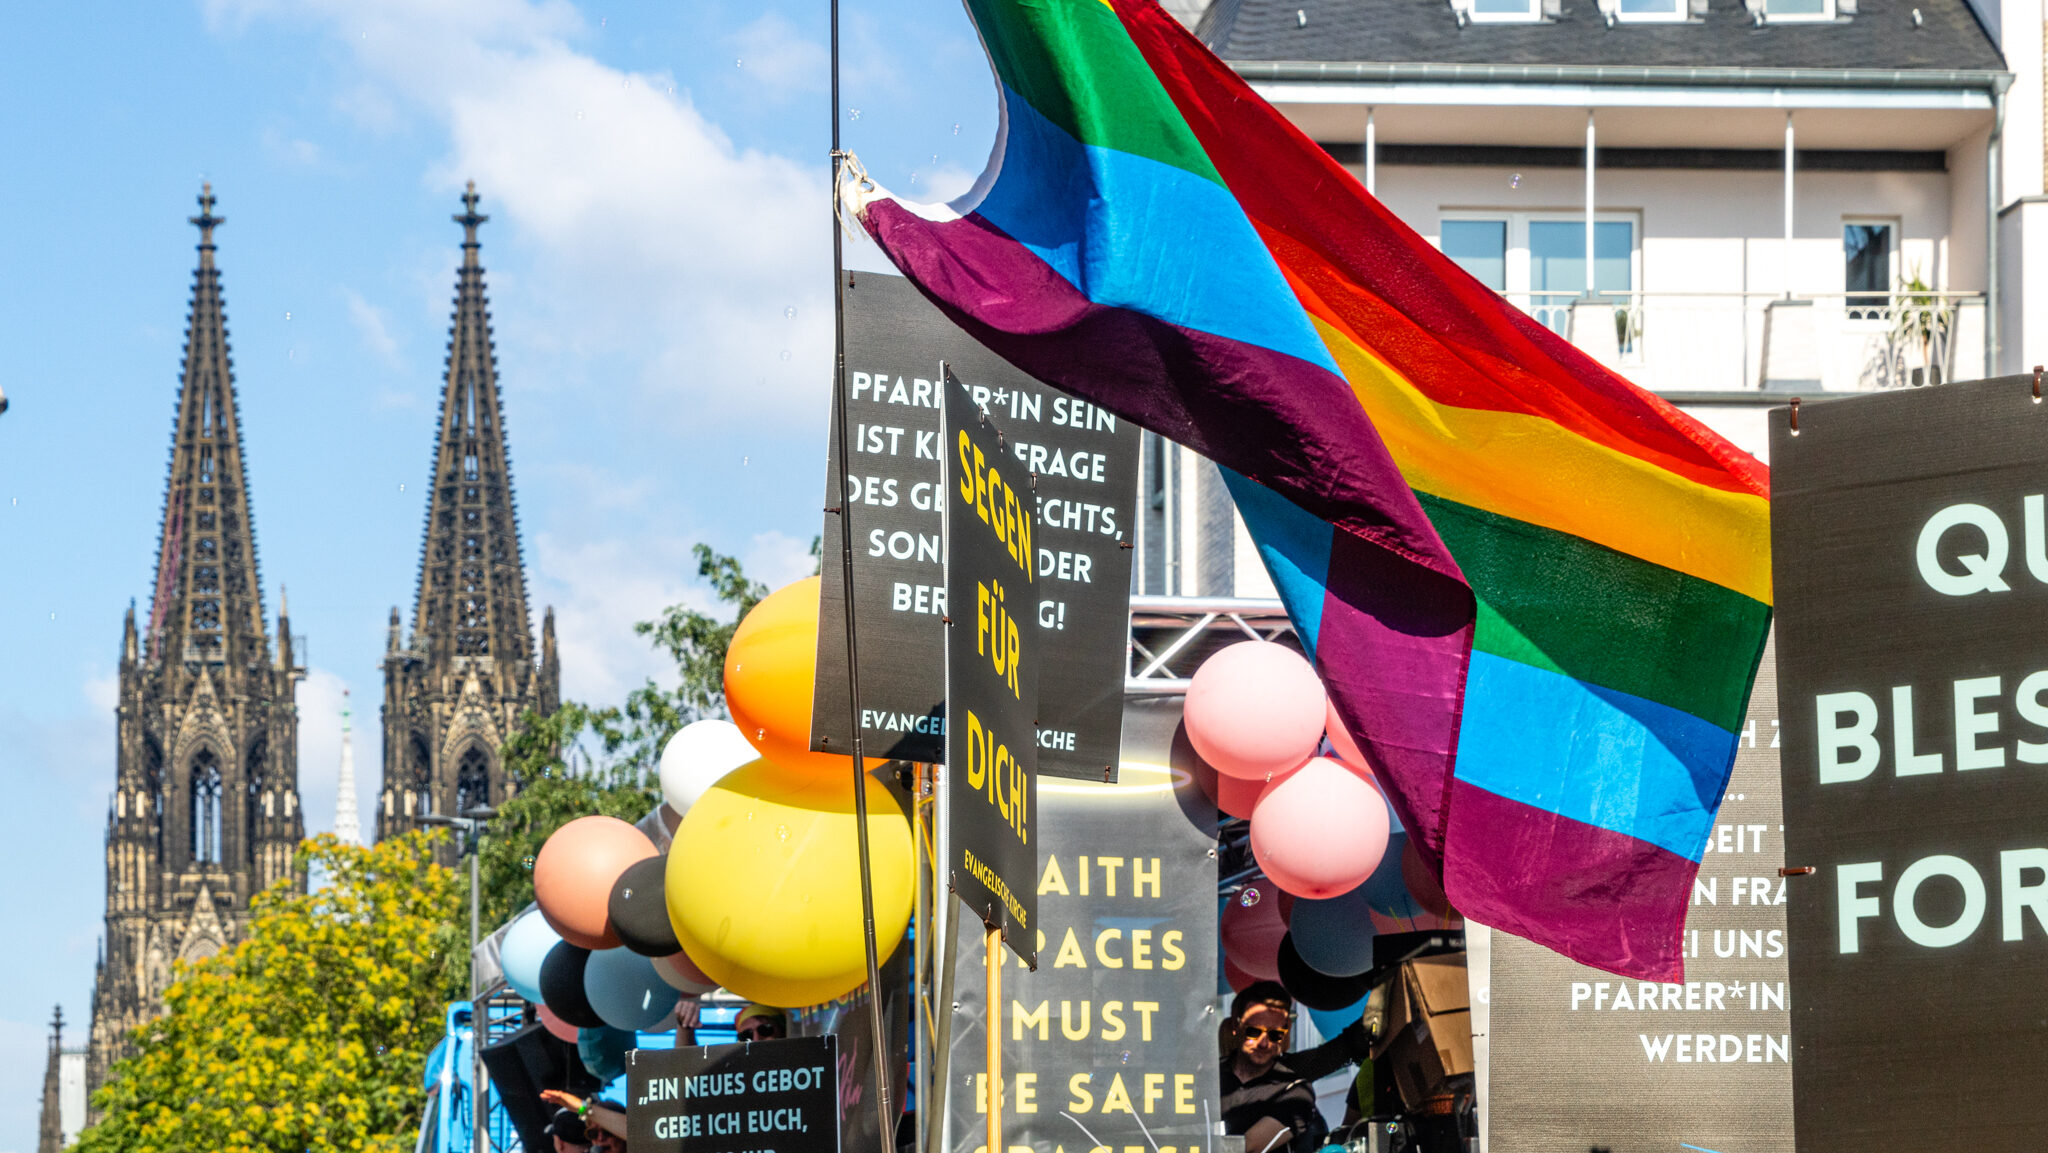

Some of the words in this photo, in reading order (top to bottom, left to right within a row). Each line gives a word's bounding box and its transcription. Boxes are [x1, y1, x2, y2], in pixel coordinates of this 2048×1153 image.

[852, 371, 1041, 423] PFARRIN
[1052, 397, 1116, 434] SEIN
[857, 424, 904, 456] IST
[959, 429, 1032, 584] SEGEN
[1039, 548, 1092, 583] DER
[978, 578, 1020, 701] FÜR
[967, 709, 1027, 845] DICH!
[964, 848, 1010, 908] EVANGELISCHE
[1009, 892, 1027, 930] KIRCHE
[1836, 847, 2048, 955] FOR
[1714, 929, 1785, 958] UNS
[1571, 980, 1791, 1011] PFARRERIN
[1012, 999, 1160, 1041] MUST
[1639, 1033, 1789, 1063] WERDEN
[685, 1072, 746, 1099] NEUES
[752, 1066, 825, 1091] GEBOT
[1068, 1071, 1196, 1114] SAFE
[655, 1114, 702, 1139] GEBE
[708, 1112, 741, 1135] ICH
[748, 1108, 808, 1133] EUCH,
